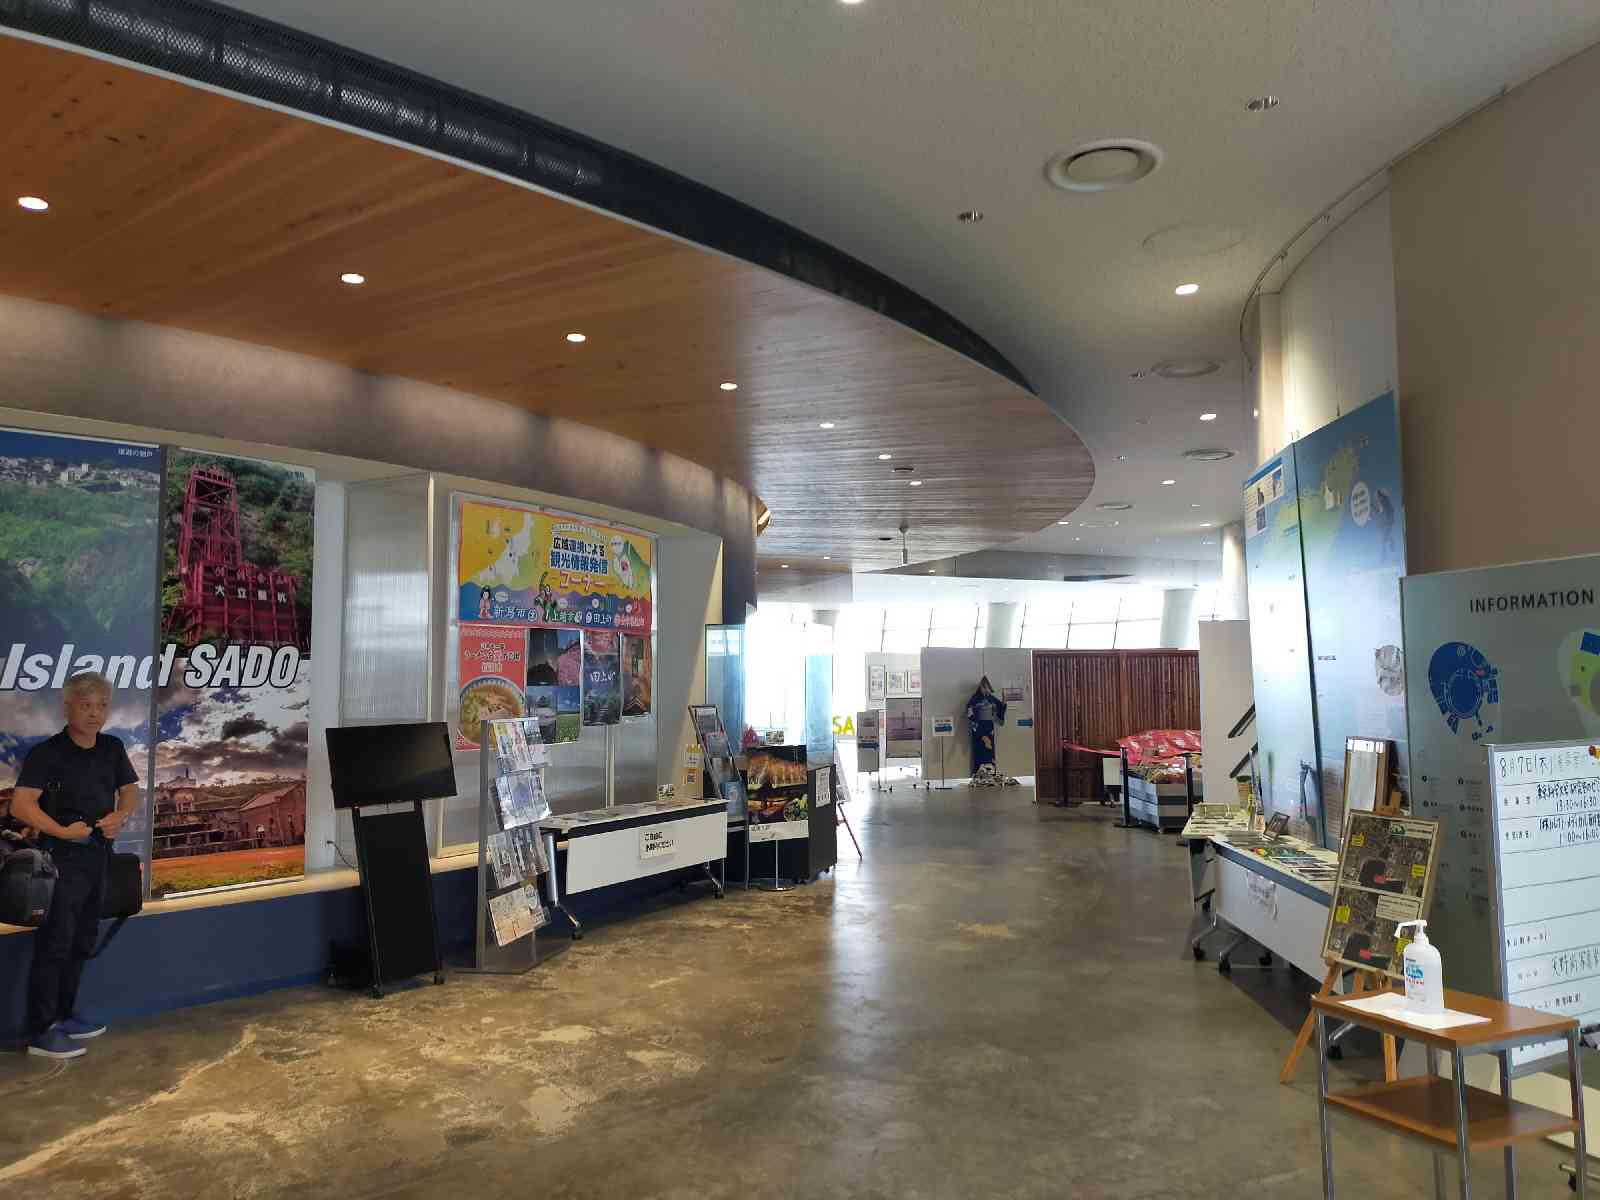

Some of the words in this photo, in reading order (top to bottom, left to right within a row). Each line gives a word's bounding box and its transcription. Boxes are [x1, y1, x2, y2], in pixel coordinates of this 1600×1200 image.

[550, 550, 608, 575] 観光情報発信
[1470, 588, 1594, 613] INFORMATION
[184, 644, 301, 689] SADO
